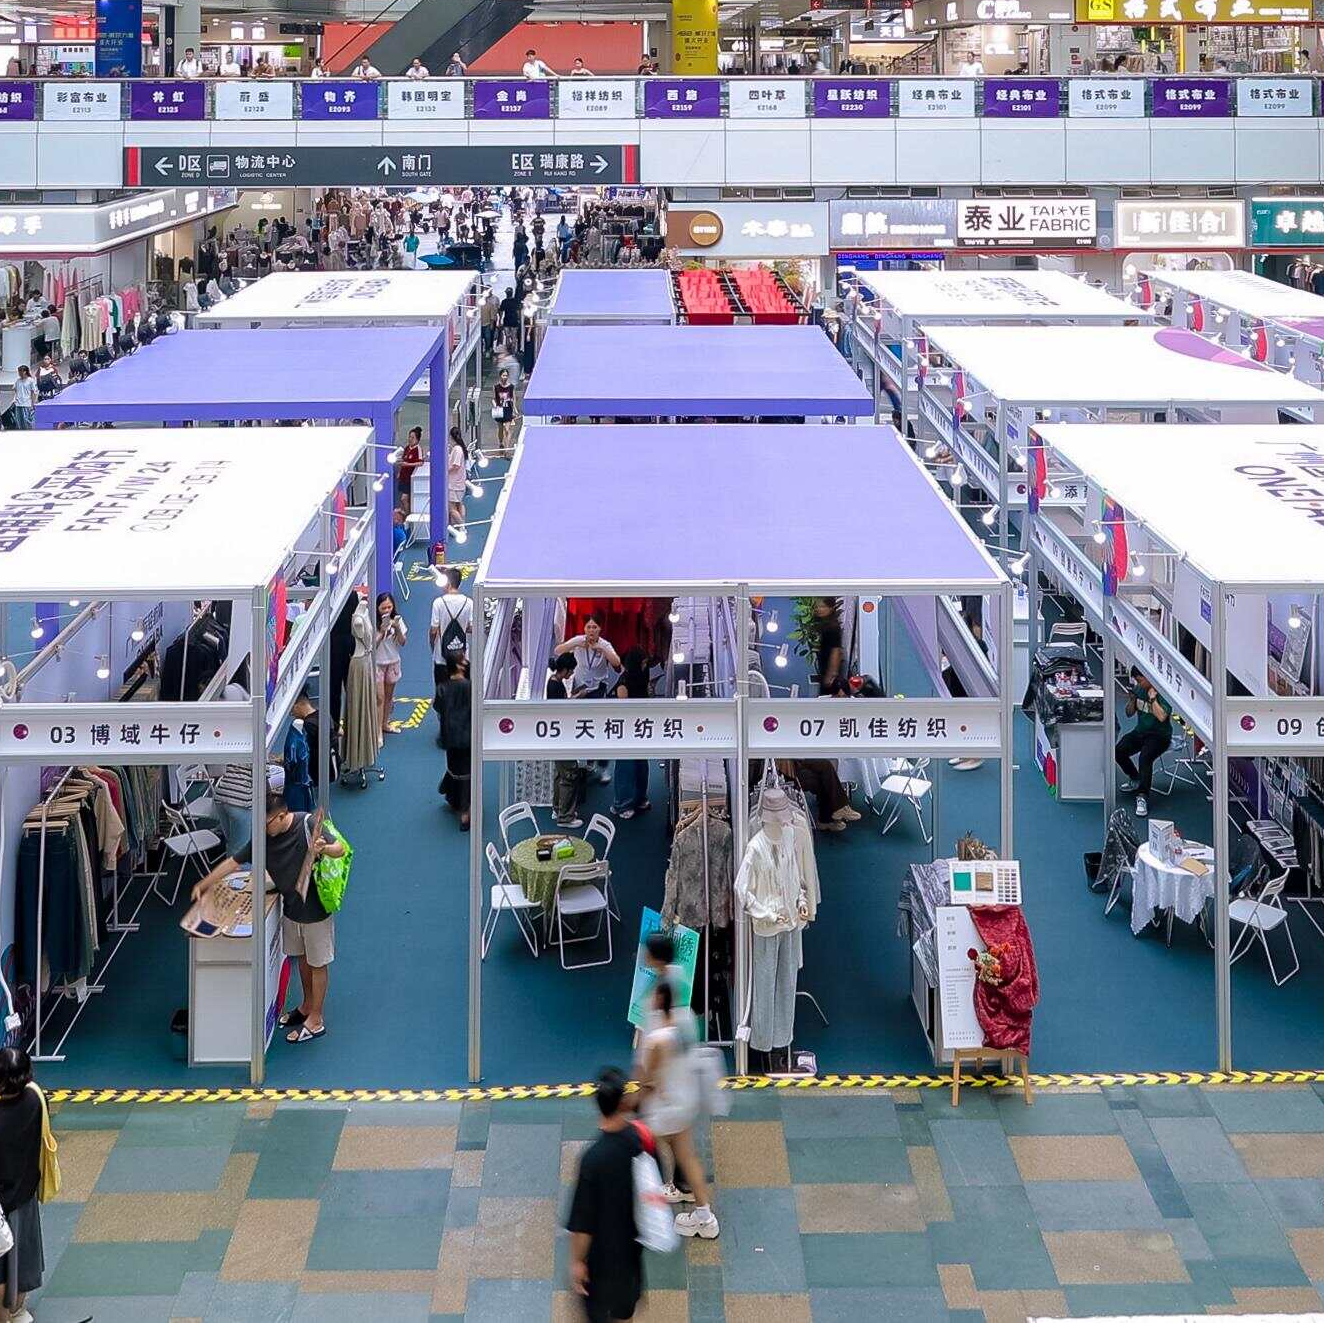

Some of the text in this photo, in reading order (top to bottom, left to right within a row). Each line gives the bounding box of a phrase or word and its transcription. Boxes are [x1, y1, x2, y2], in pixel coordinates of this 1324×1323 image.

[56, 91, 108, 103] 彩富布业
[748, 90, 786, 101] 四叶草
[912, 89, 962, 101] 经典布业
[995, 88, 1048, 101] 经典布业
[1081, 87, 1132, 100] 格式布业
[1165, 88, 1217, 101] 格式布业
[1249, 87, 1301, 100] 格式布业
[1179, 103, 1202, 111] E2099
[178, 154, 201, 172] D区
[235, 154, 296, 171] 物流中心
[401, 154, 432, 171] 南门
[511, 153, 535, 171] E区
[539, 153, 585, 170] 瑞康路
[964, 204, 1025, 232] 泰业
[1029, 218, 1092, 232] FABRIC
[50, 721, 203, 746] 03 博域牛仔
[535, 717, 684, 740] 05 天柯纺织
[799, 717, 947, 739] 07 凯佳纺织
[1276, 717, 1303, 737] 09
